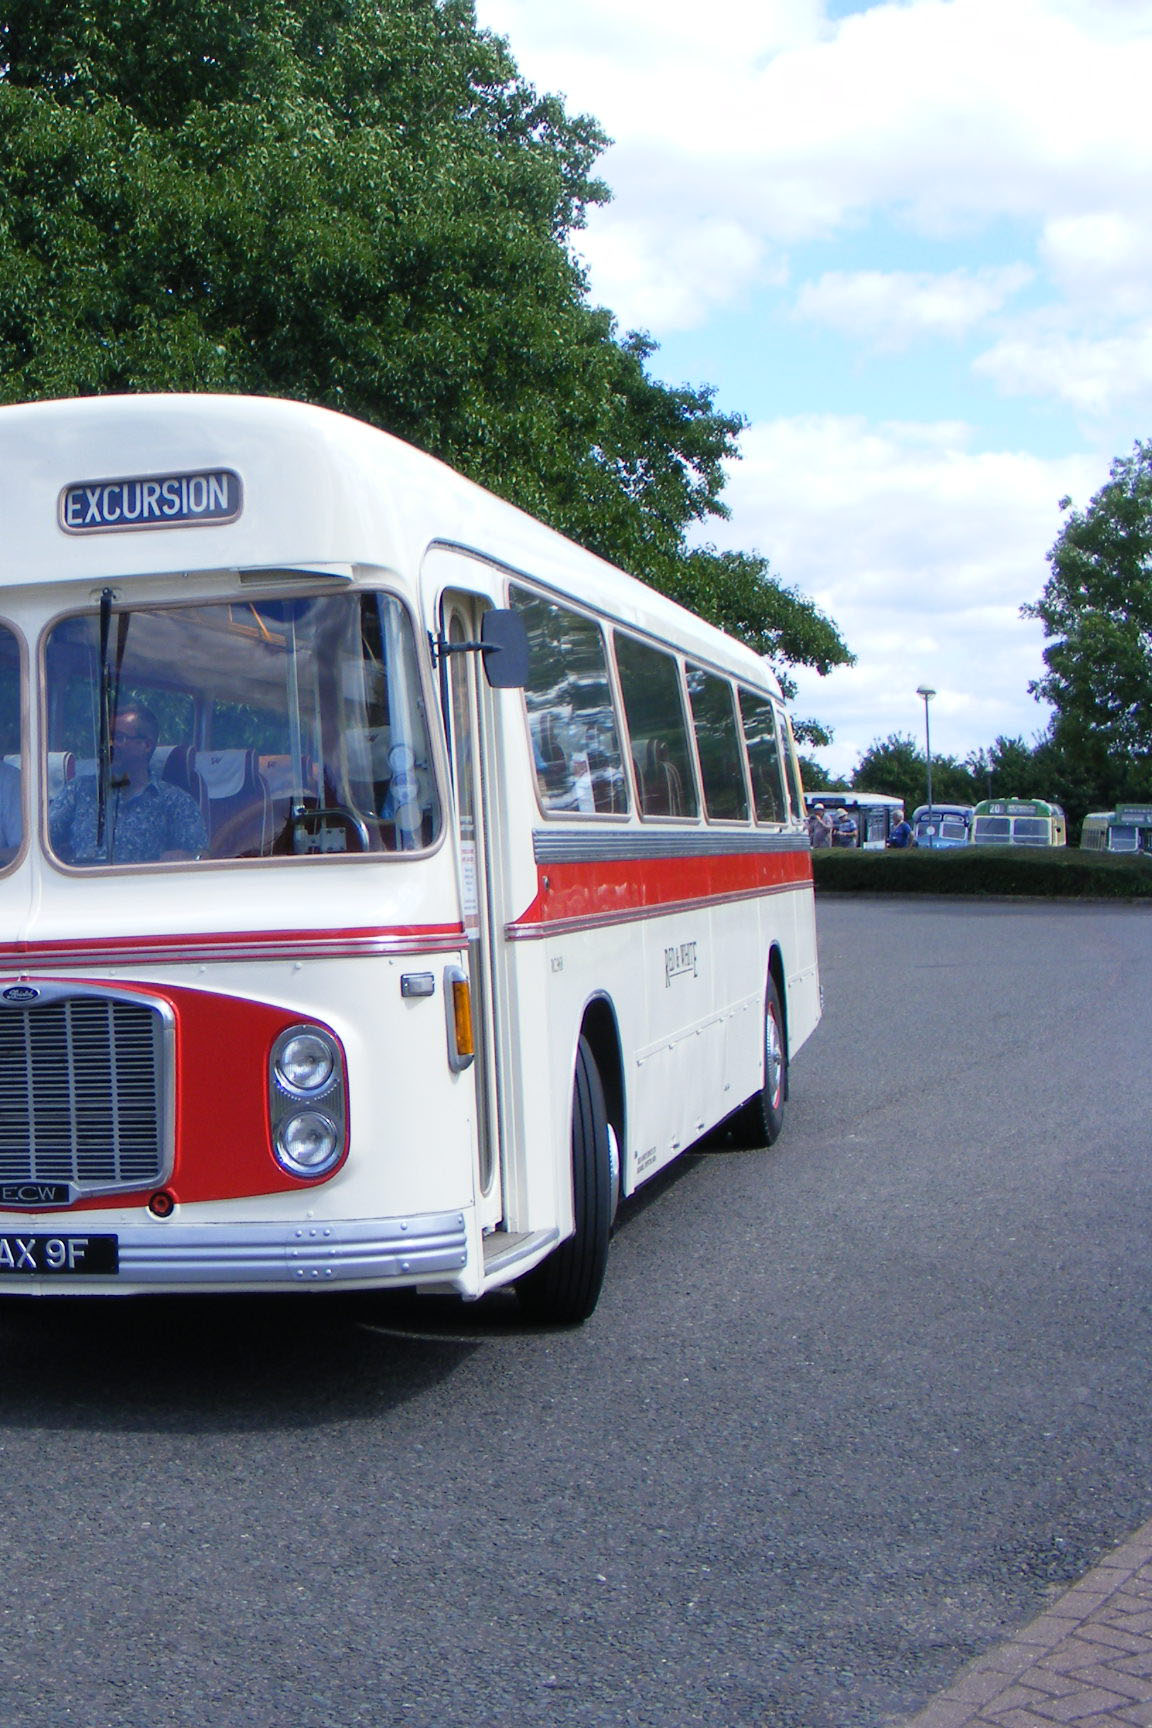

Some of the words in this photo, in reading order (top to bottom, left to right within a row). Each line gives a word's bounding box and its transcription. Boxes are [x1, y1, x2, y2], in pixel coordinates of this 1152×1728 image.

[66, 474, 229, 525] EXCURSION
[2, 1186, 57, 1201] ECW
[45, 1238, 89, 1269] 9F
